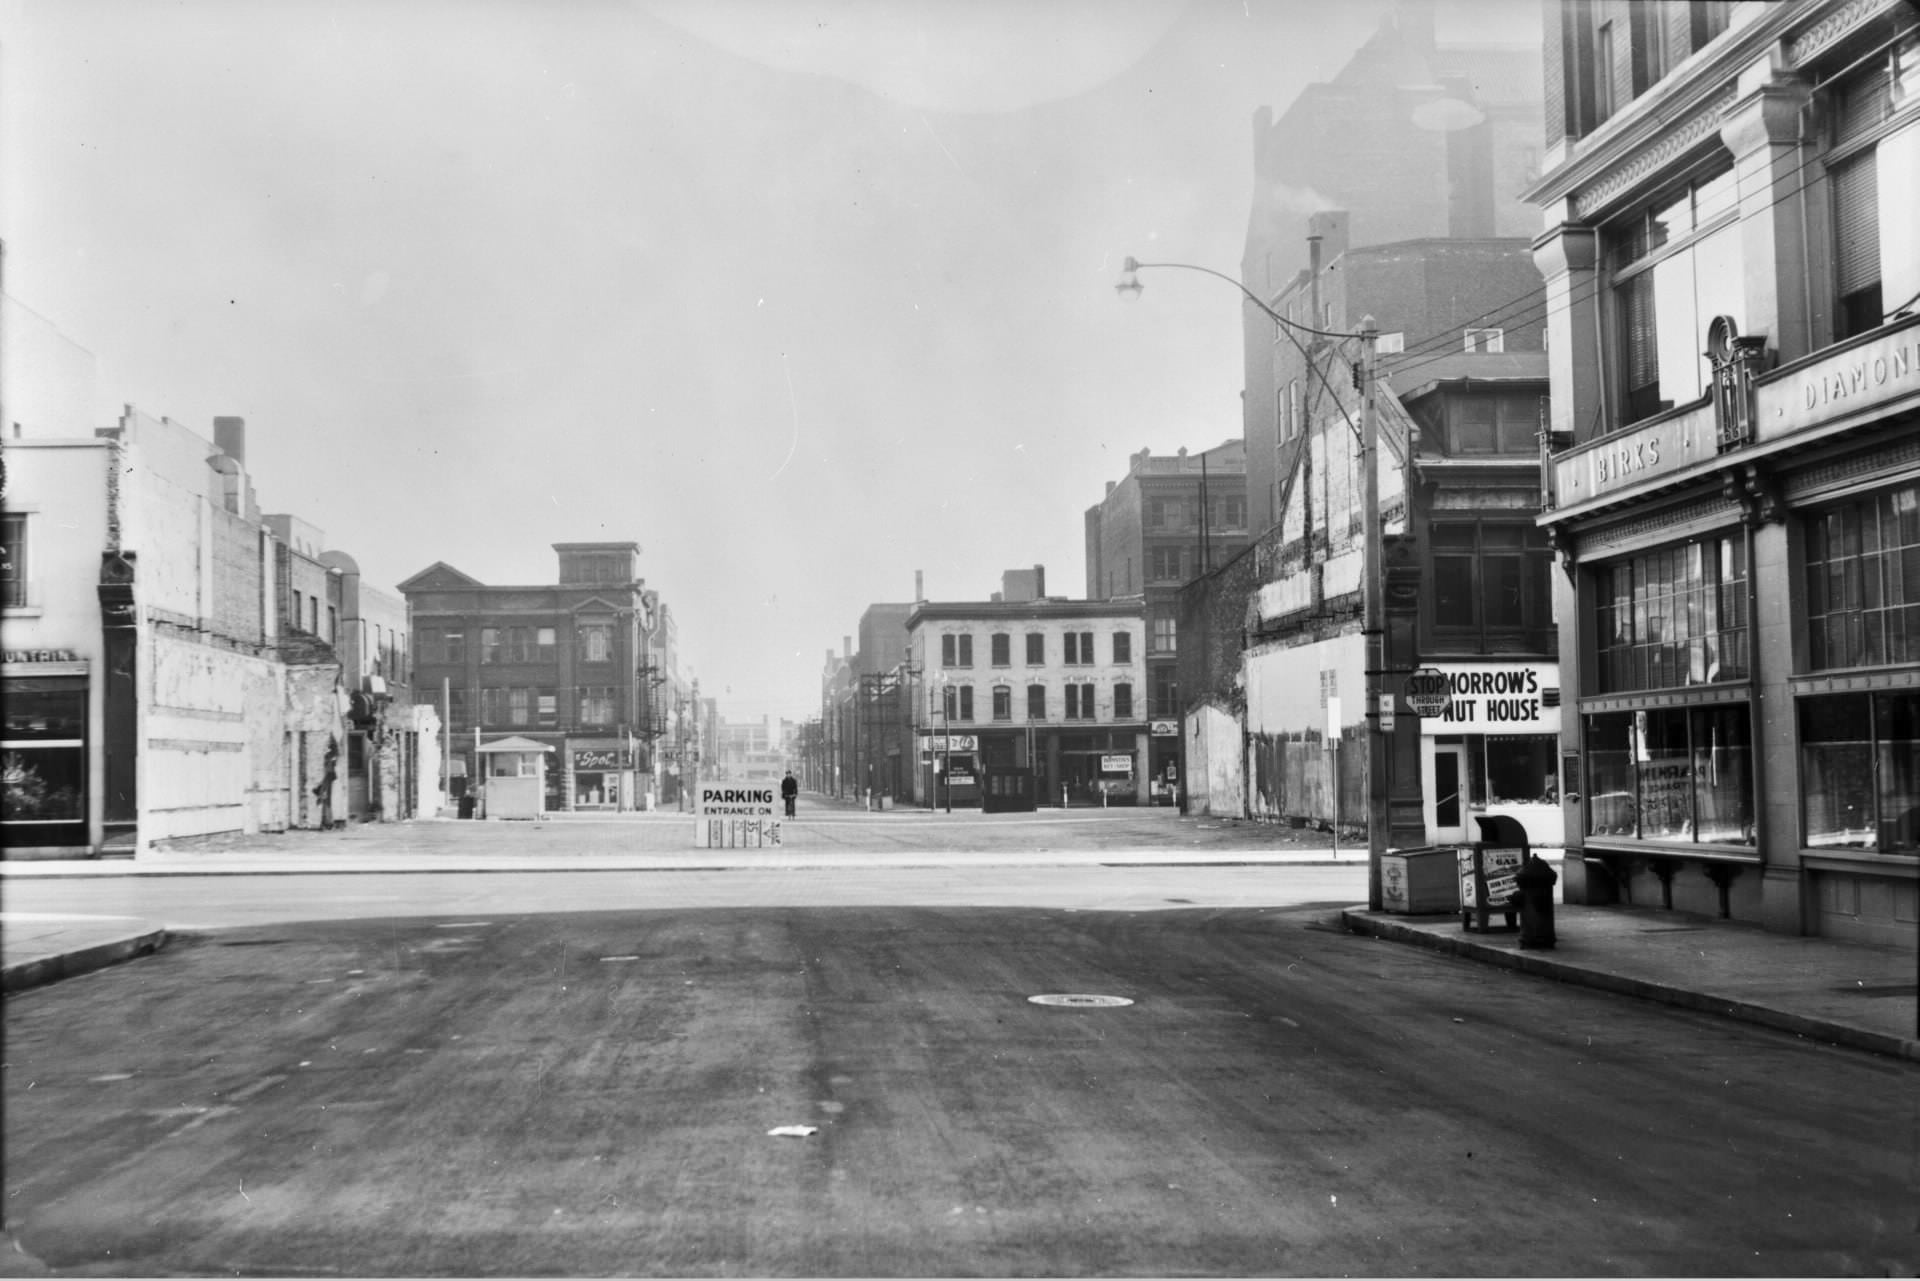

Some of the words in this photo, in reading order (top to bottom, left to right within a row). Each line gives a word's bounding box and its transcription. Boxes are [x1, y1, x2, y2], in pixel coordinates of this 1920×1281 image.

[1806, 343, 1919, 410] DIAMON
[1600, 438, 1660, 482] BIRKS
[1411, 676, 1444, 694] STOP
[1444, 668, 1538, 694] MORROW'S
[1412, 696, 1445, 705] THROUGH
[1417, 705, 1441, 714] STREET
[1443, 700, 1476, 722] NUT
[1487, 699, 1540, 722] HOUSE
[703, 789, 773, 804] PARKING
[704, 807, 754, 815] ENTRANCE
[758, 807, 772, 815] ON
